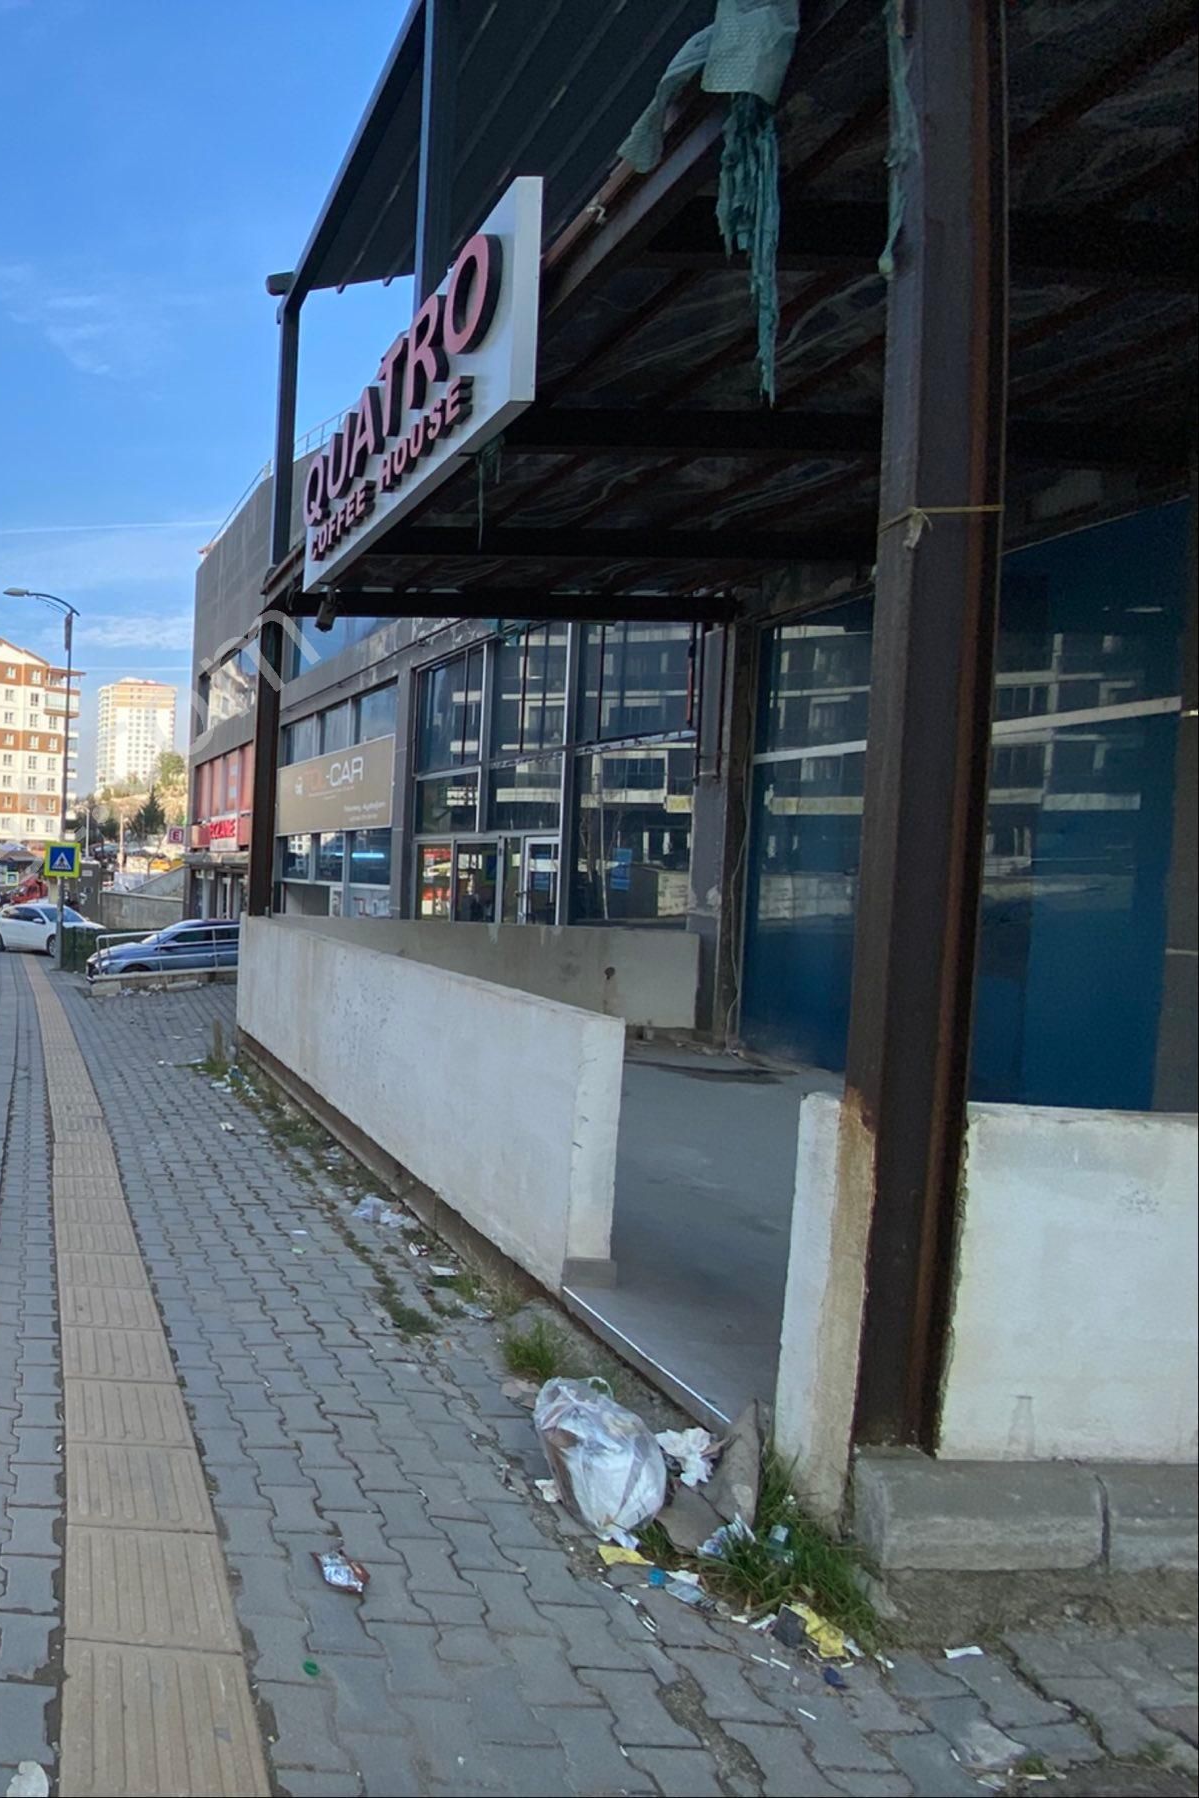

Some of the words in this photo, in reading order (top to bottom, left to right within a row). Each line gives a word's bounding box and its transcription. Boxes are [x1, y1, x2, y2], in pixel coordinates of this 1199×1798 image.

[304, 234, 502, 527] QUATRO
[309, 481, 375, 561] COFFEE
[379, 376, 474, 493] HOUSE
